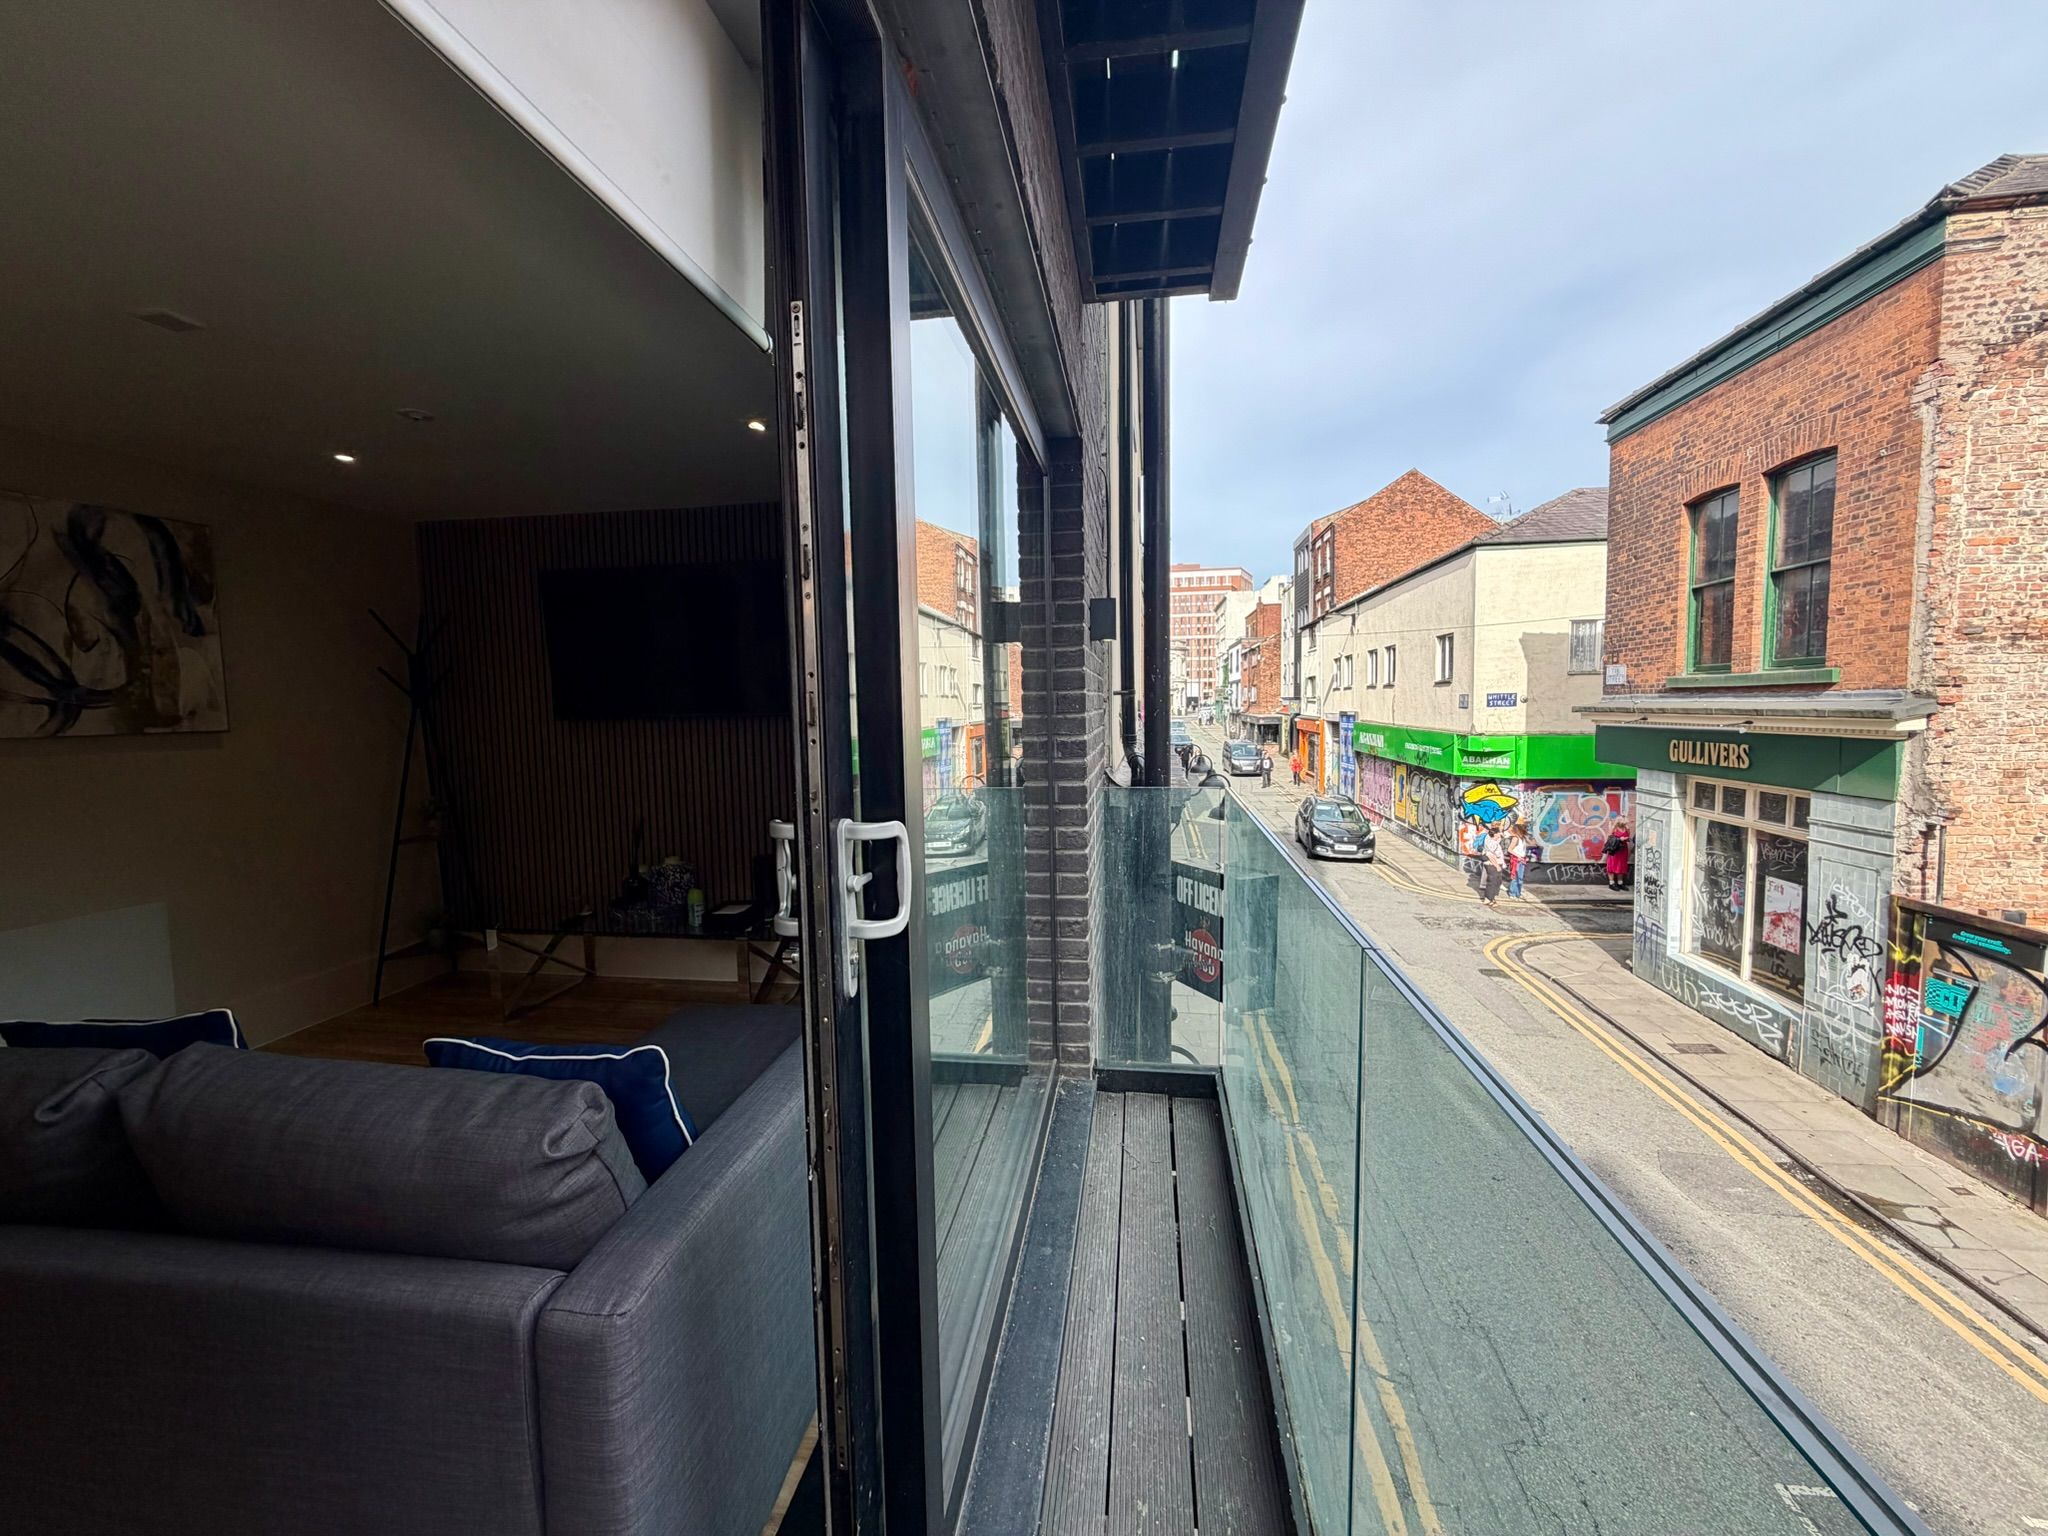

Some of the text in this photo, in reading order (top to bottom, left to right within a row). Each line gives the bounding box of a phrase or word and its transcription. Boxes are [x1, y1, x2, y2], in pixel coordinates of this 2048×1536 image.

[1462, 755, 1510, 765] ABAKHAN
[1669, 739, 1750, 769] GULLIVERS
[1176, 876, 1193, 906] OFF
[1185, 931, 1223, 961] Havana
